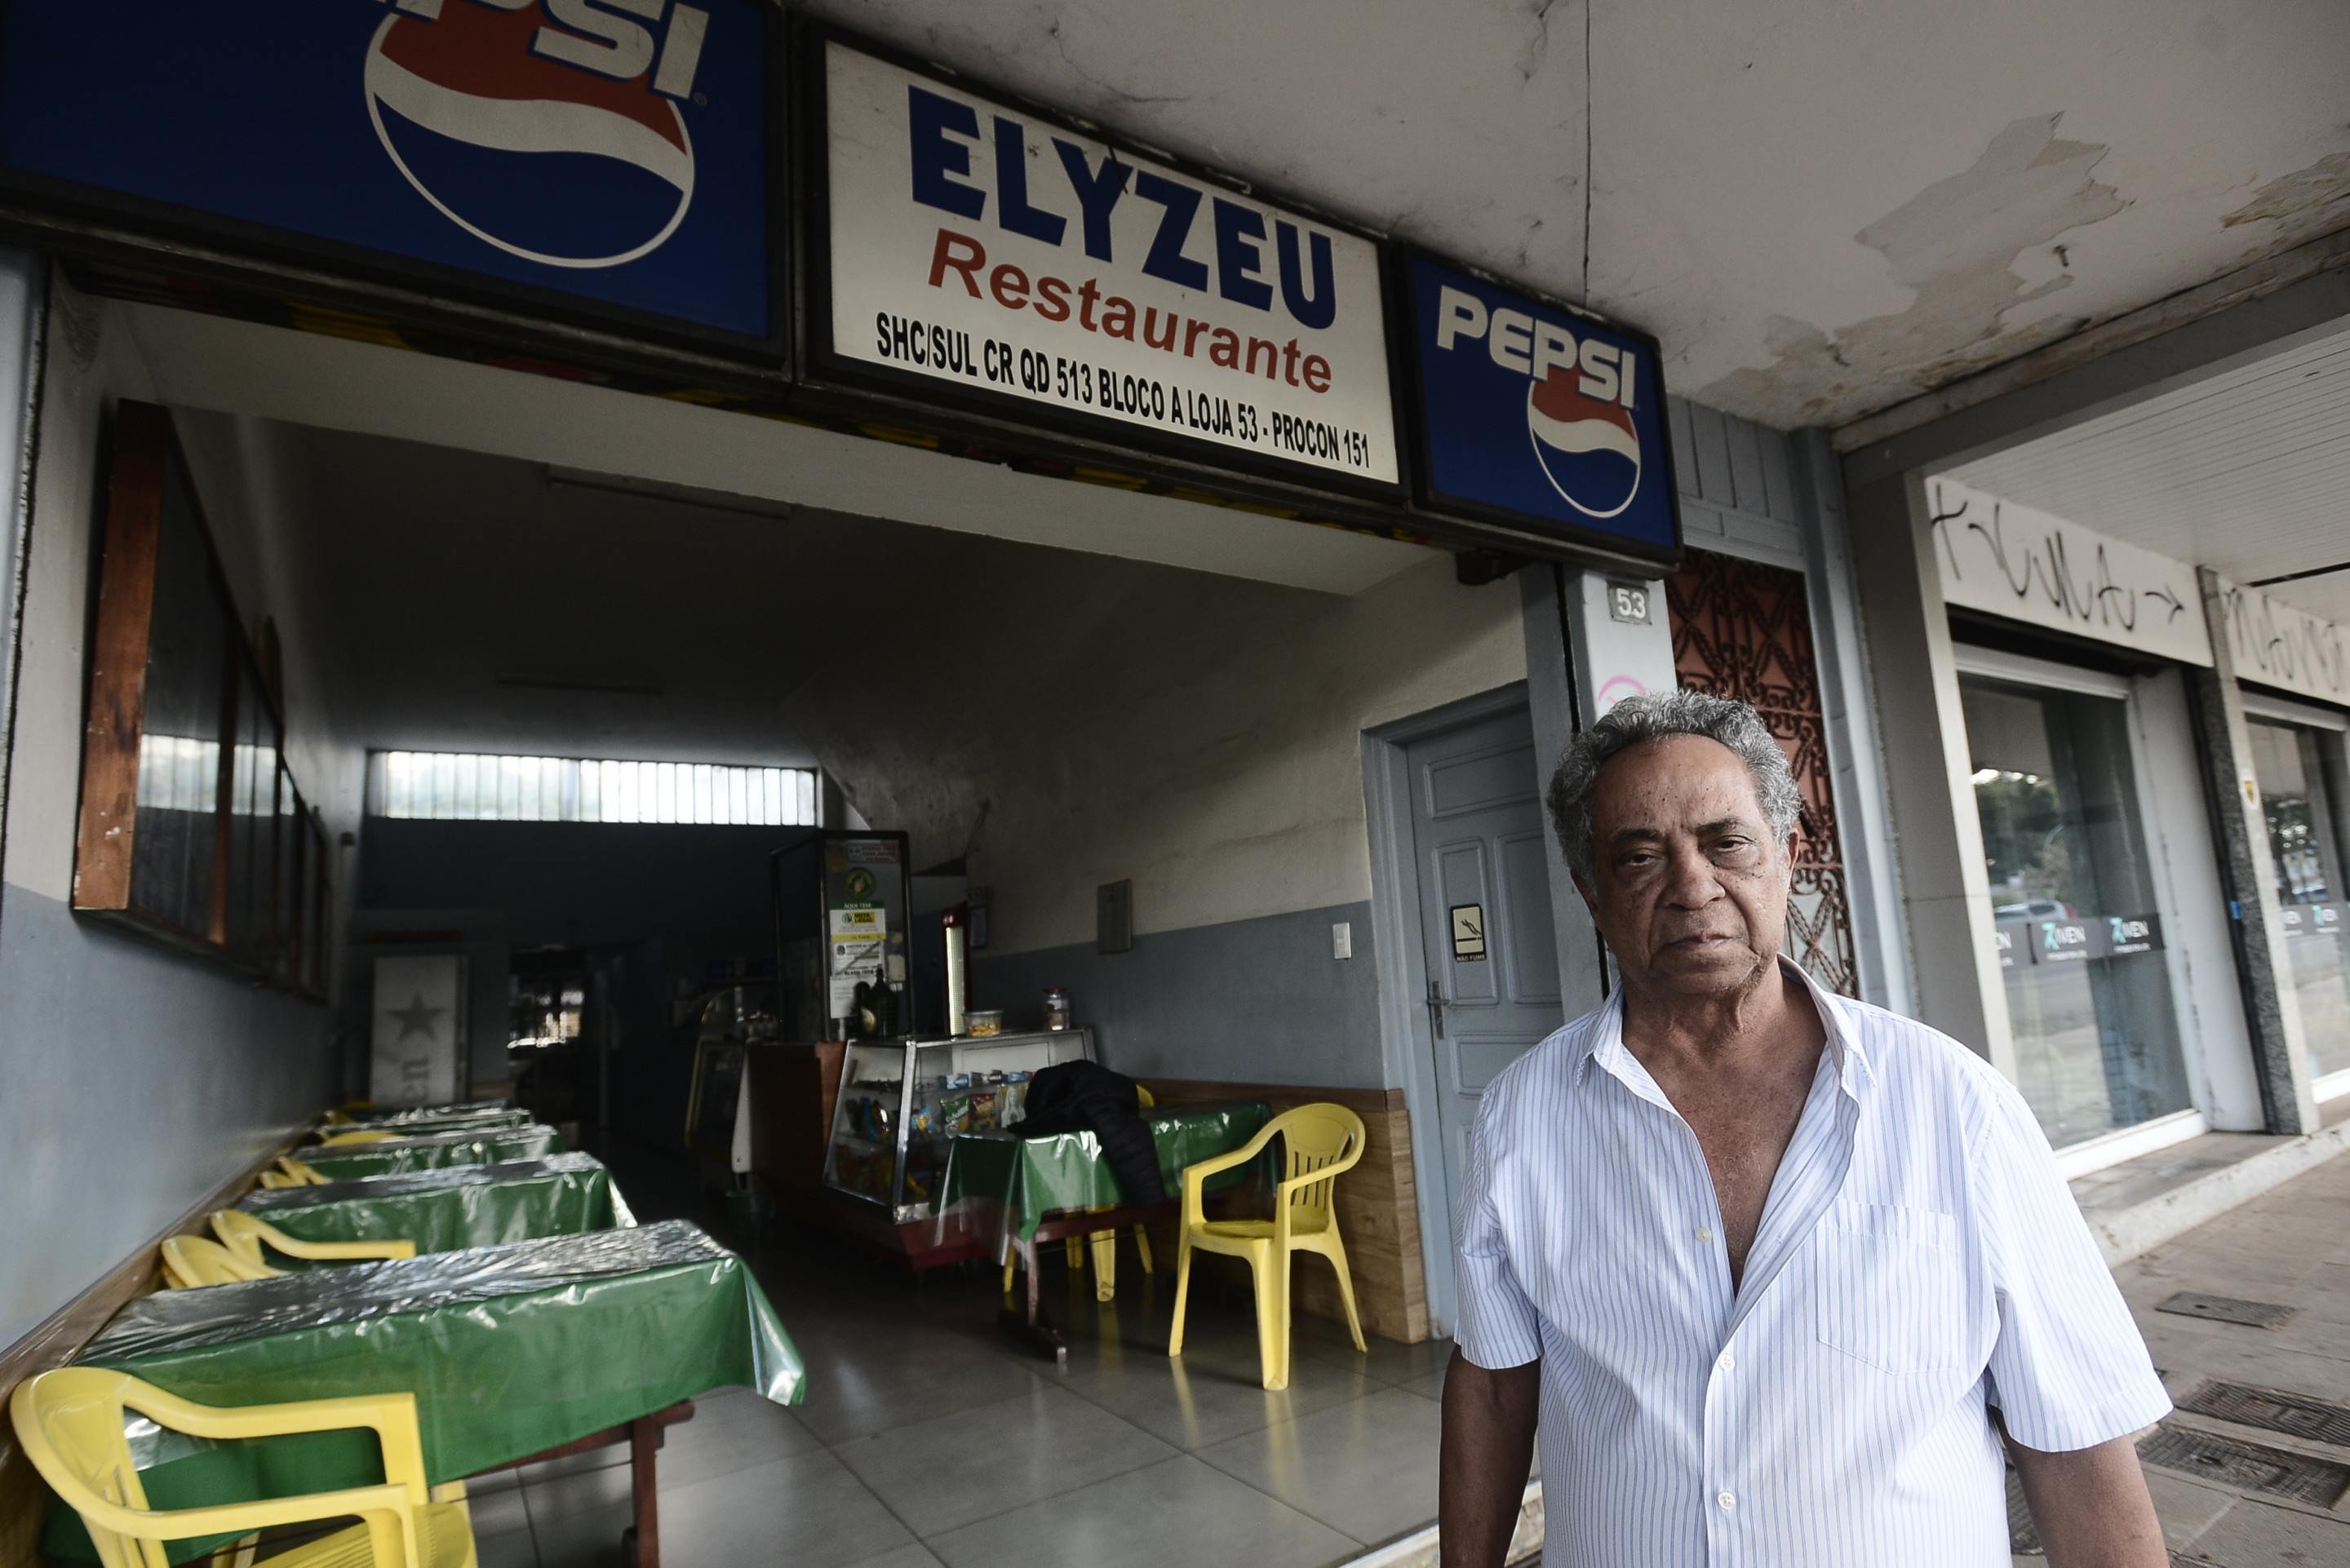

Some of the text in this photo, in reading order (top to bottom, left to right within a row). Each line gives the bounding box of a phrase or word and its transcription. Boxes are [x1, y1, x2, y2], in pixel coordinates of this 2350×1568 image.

[907, 84, 1337, 330] ELYZEU
[928, 227, 1332, 393] Restaurante
[1437, 285, 1636, 409] PEPSI
[876, 312, 978, 377] SHC/SUL
[983, 339, 1014, 386] CR
[1020, 348, 1050, 394] QD
[1057, 358, 1093, 404] 513
[1098, 368, 1164, 421] BLOCO
[1171, 386, 1184, 425] A
[1187, 389, 1234, 437] LOJA
[1238, 403, 1258, 443] 53
[1271, 411, 1340, 461] PROCON
[1344, 429, 1370, 468] 151
[1616, 587, 1647, 619] 53
